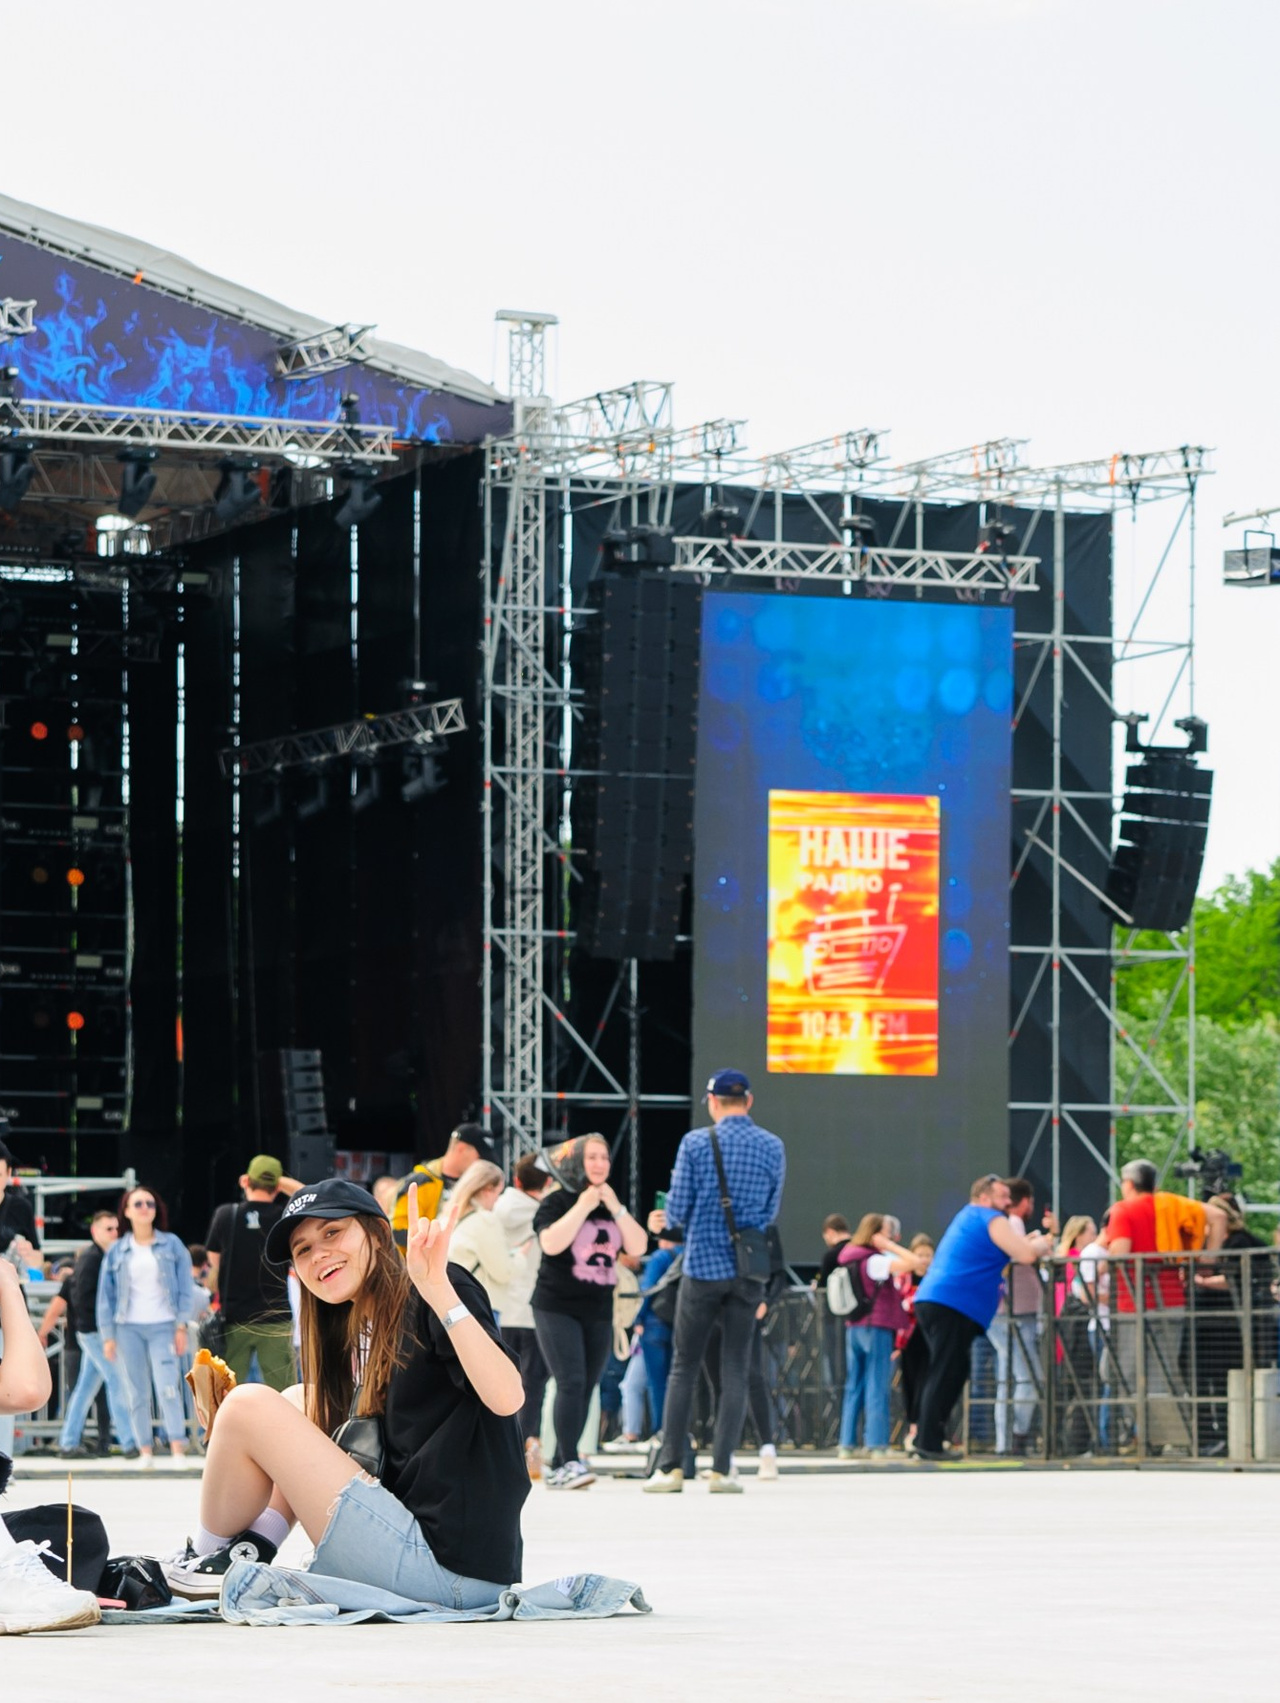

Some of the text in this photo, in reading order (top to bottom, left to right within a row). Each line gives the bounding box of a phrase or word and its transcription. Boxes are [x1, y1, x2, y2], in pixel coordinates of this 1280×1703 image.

[799, 827, 911, 871] НАШЕ
[798, 874, 884, 895] РАДИО
[798, 1012, 908, 1042] 104.7 FM
